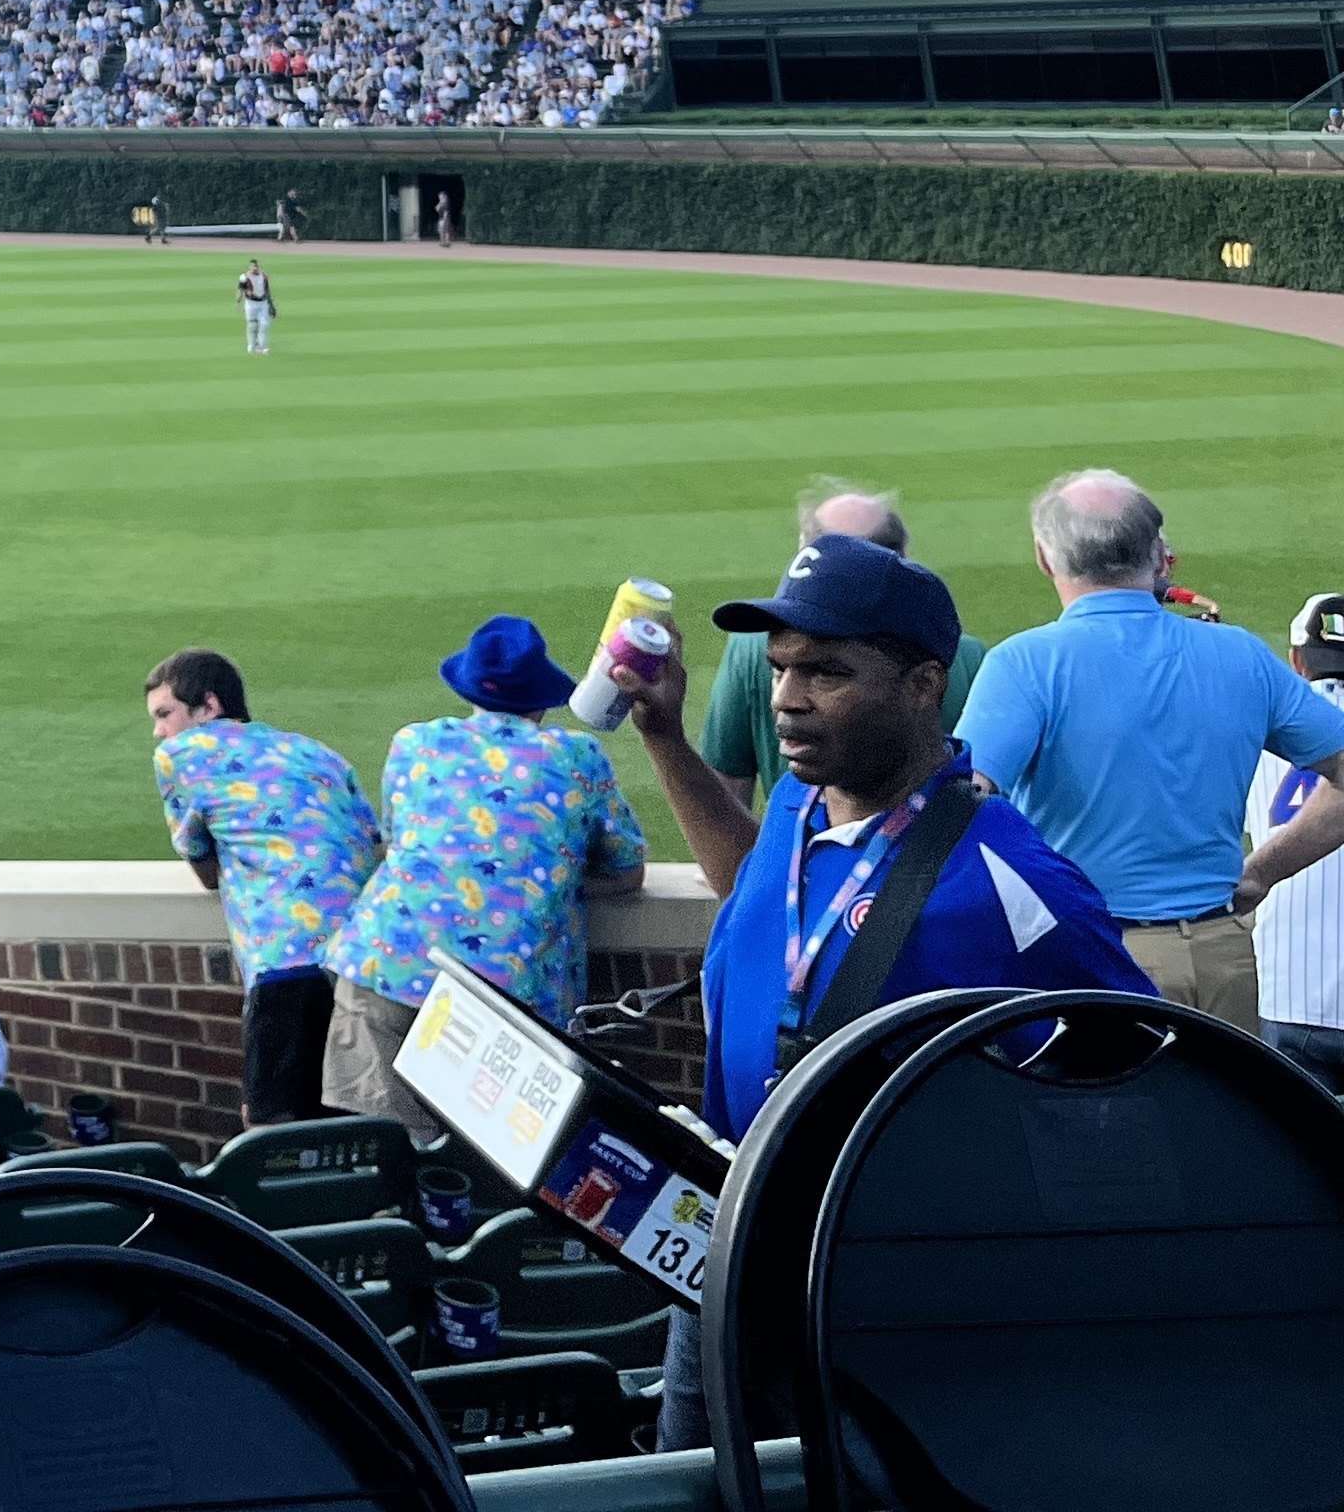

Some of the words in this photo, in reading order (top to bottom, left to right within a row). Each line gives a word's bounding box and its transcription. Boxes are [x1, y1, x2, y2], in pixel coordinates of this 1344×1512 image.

[788, 546, 823, 580] C
[495, 1029, 523, 1061] BUD
[480, 1044, 518, 1086] LIGHT
[532, 1061, 563, 1095] BUD
[518, 1076, 558, 1120] LIGHT
